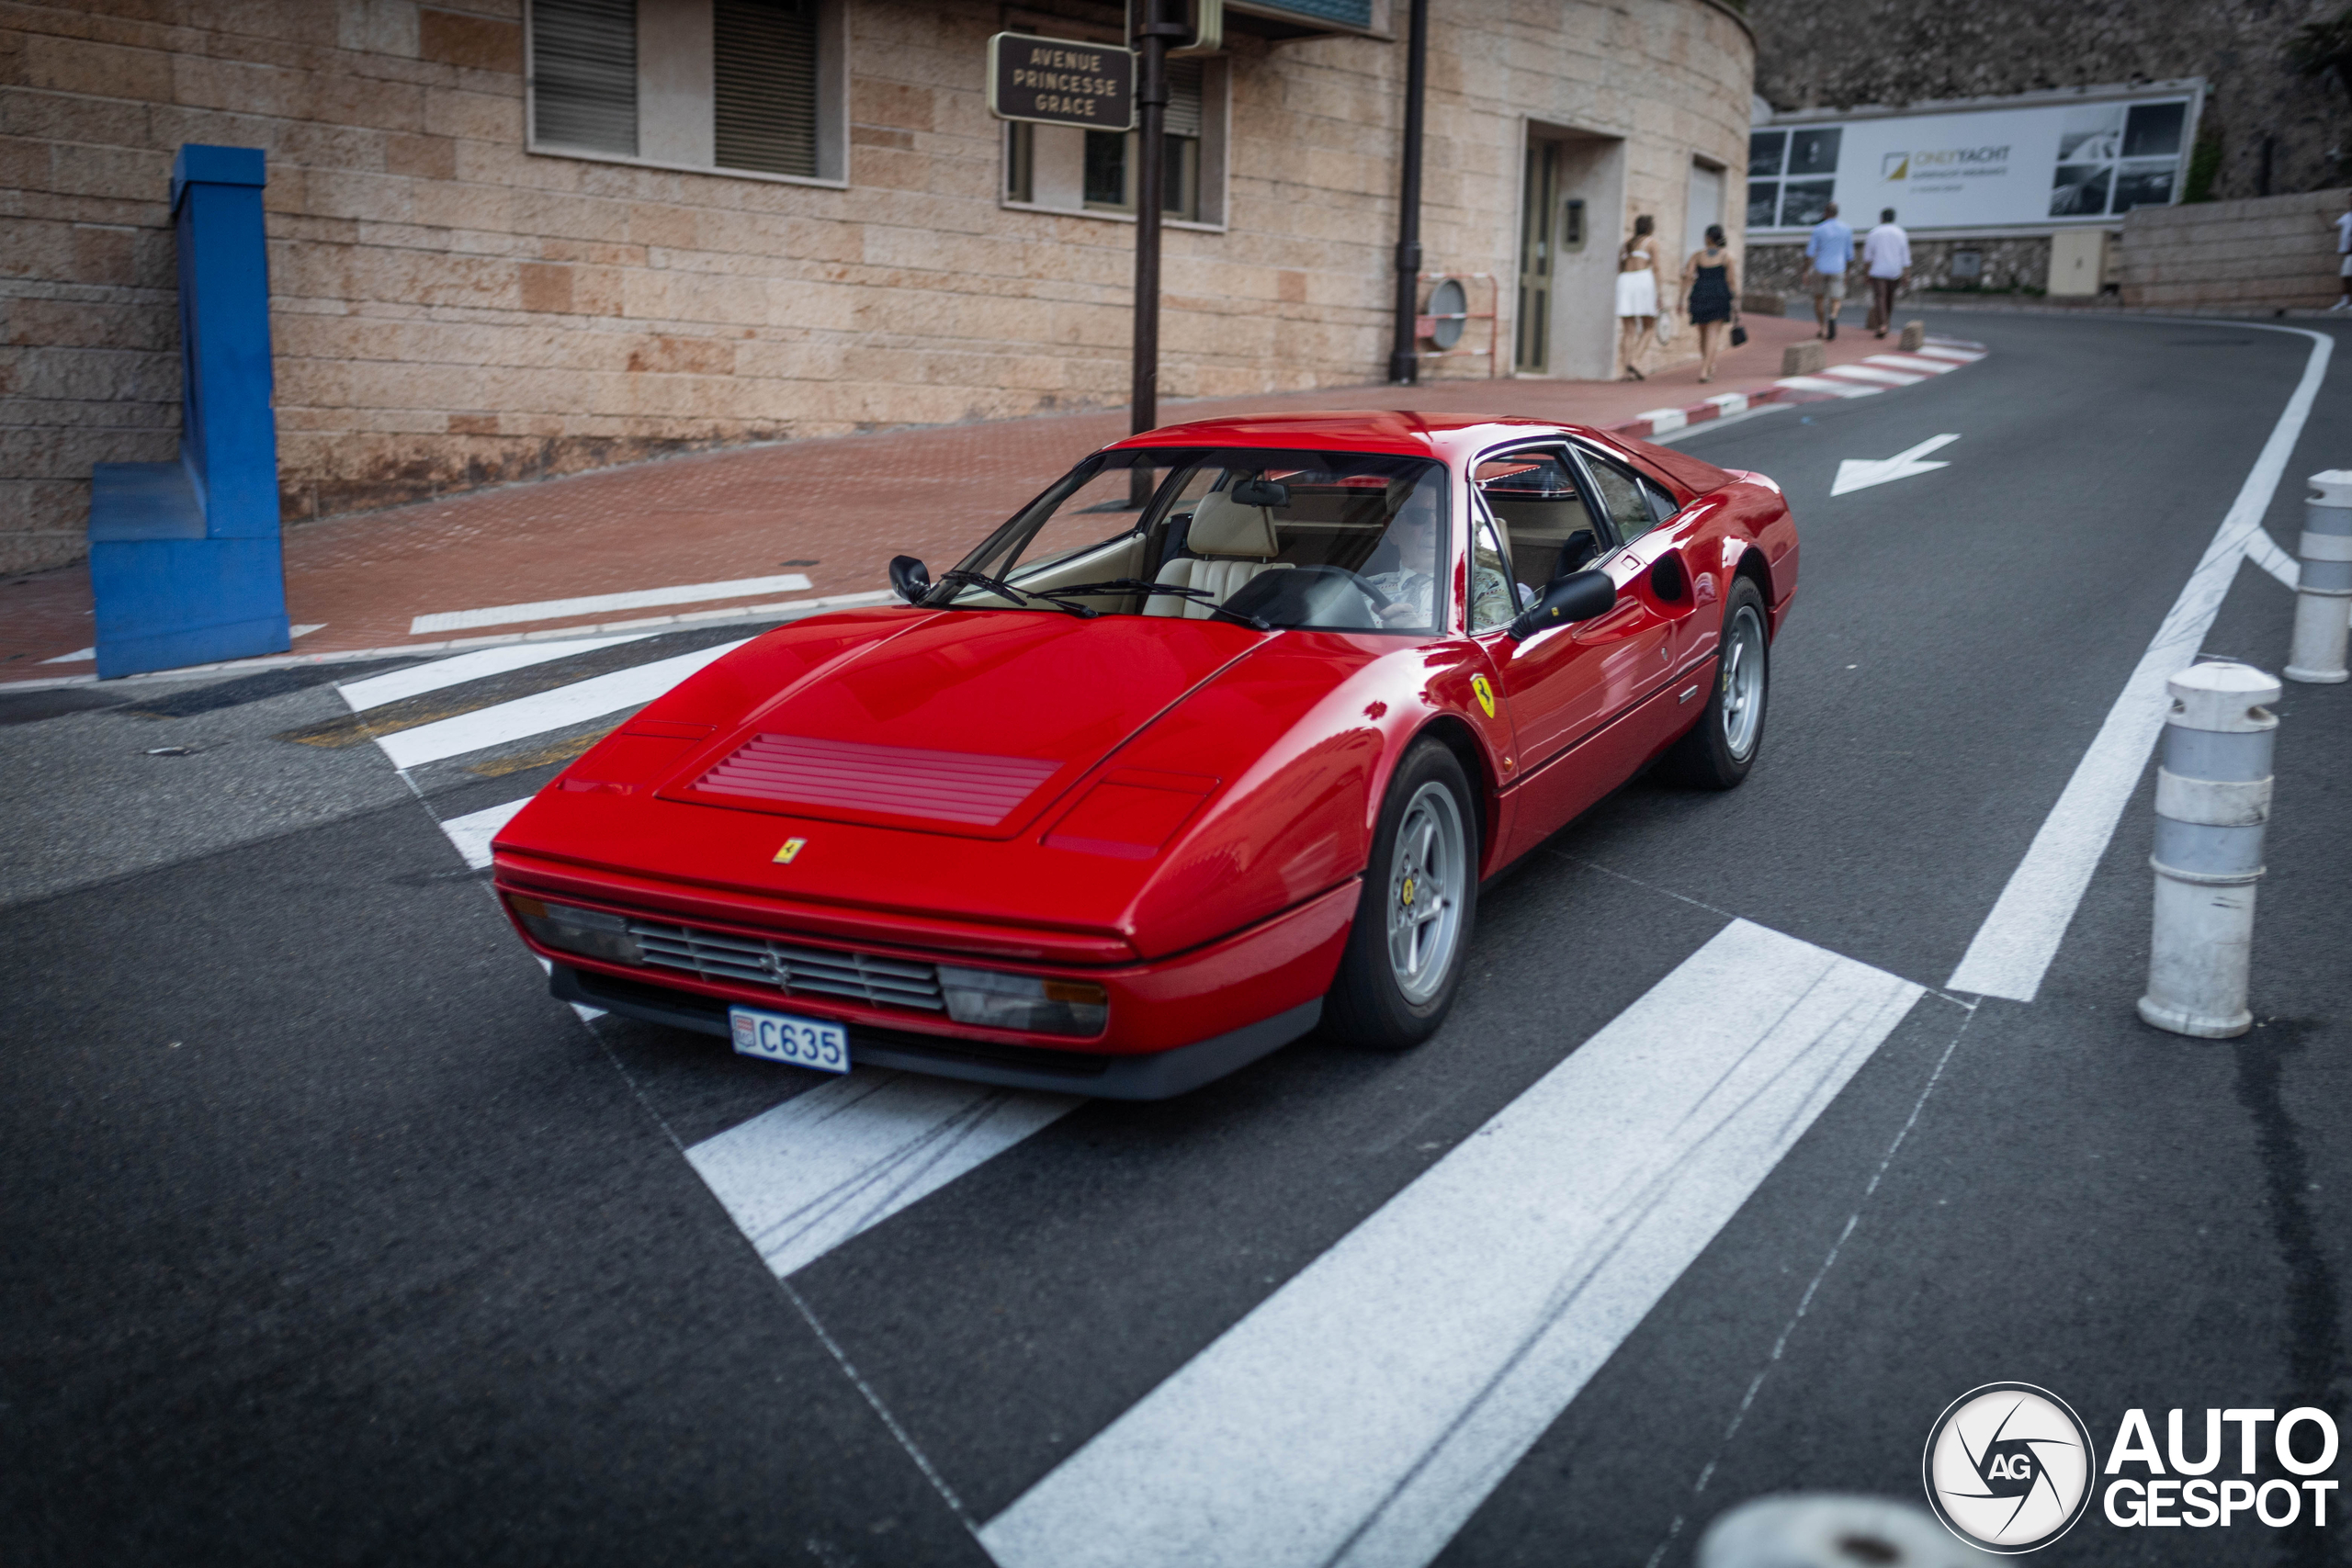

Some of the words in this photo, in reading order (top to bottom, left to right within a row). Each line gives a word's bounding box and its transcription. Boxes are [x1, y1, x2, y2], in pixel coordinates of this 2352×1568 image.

[1030, 48, 1102, 72] AVENUE
[1013, 69, 1117, 96] PRINCESSE
[1035, 94, 1095, 116] GRACE
[760, 1021, 841, 1064] C635
